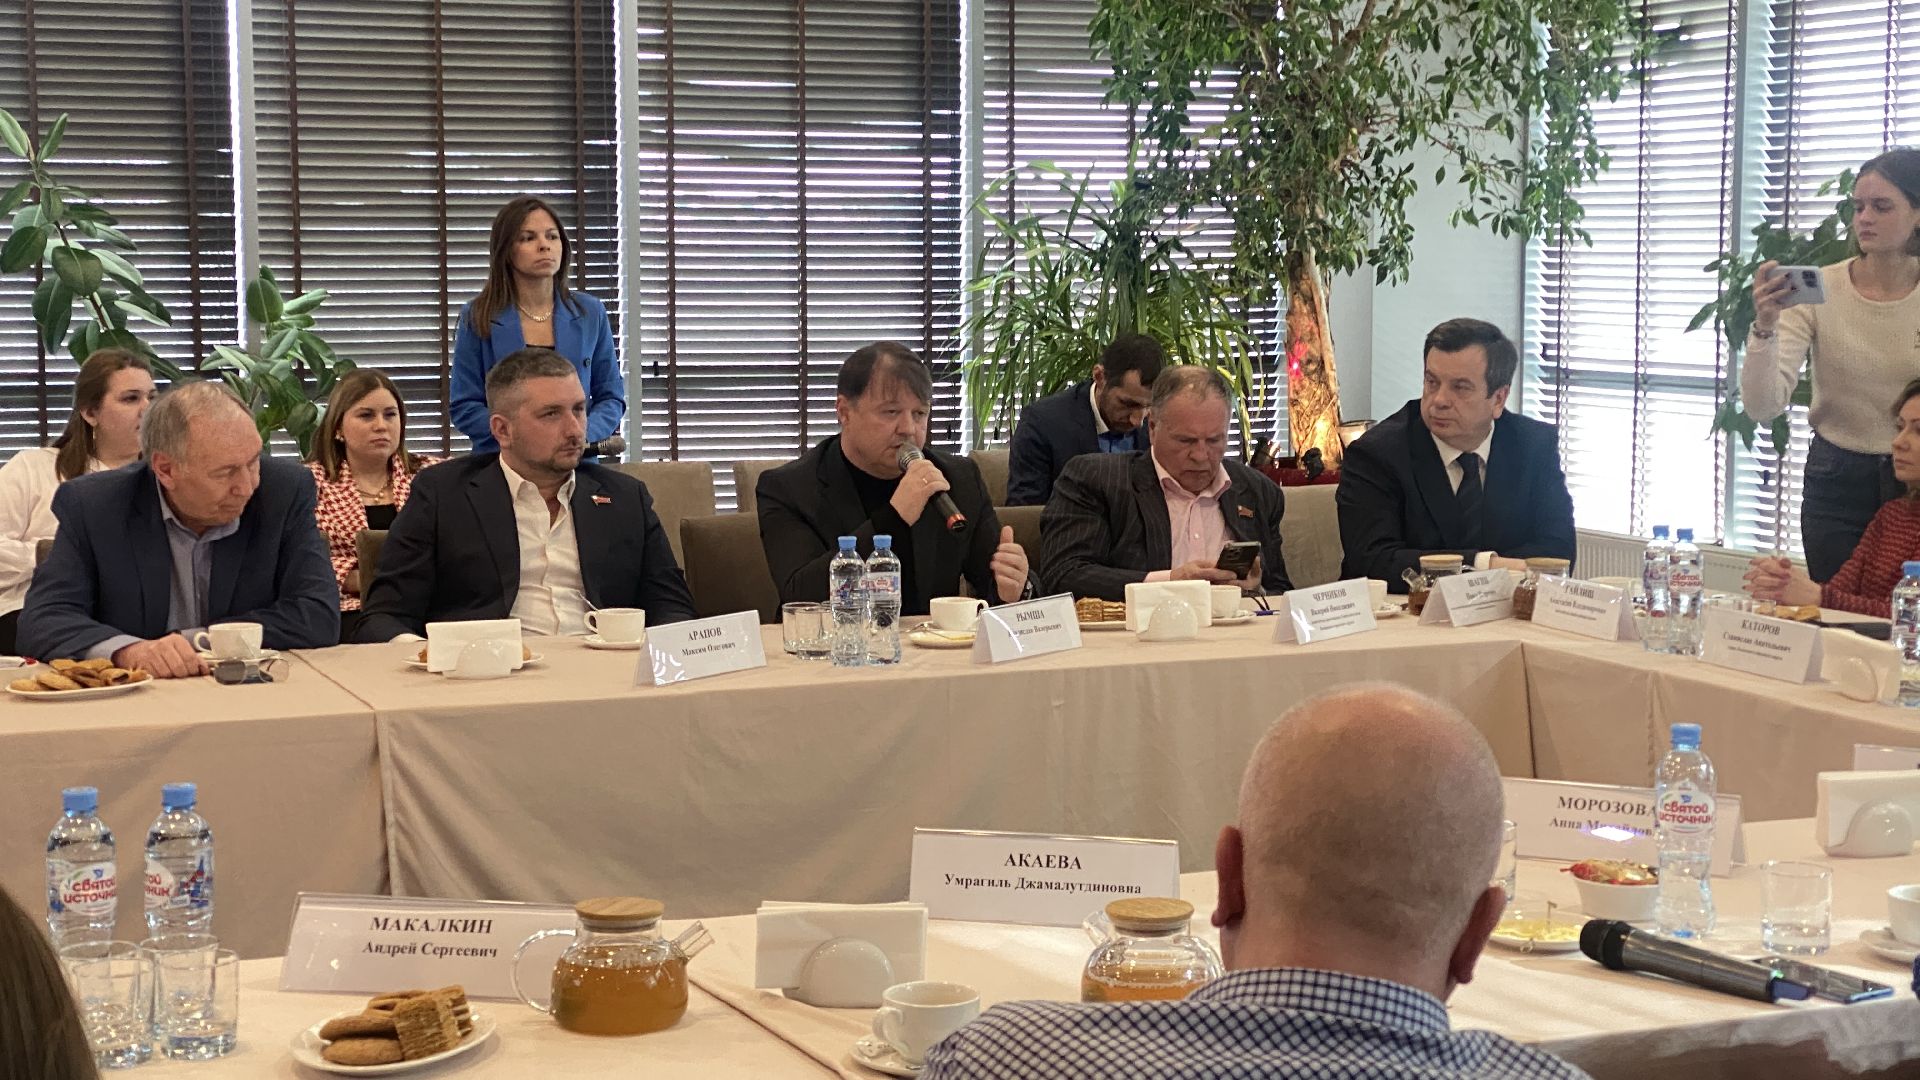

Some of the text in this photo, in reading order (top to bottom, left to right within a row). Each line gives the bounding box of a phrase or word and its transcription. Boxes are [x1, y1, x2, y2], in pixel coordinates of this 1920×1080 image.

[1312, 588, 1347, 602] ЧЕРНИКОВ
[1016, 610, 1045, 622] РЫМША
[688, 626, 722, 641] АРАПОВ
[1742, 619, 1781, 636] КАТОРОВ
[681, 642, 736, 656] Максим Олегович
[1549, 816, 1582, 830] Анна
[1004, 852, 1083, 871] АКАЕВА
[944, 872, 1142, 895] Умрагиль Джамалутдиновна
[63, 890, 115, 904] ИСТОЧН
[369, 916, 493, 935] МАКАЛКИН
[362, 941, 498, 959] Андрей Сергеевич
